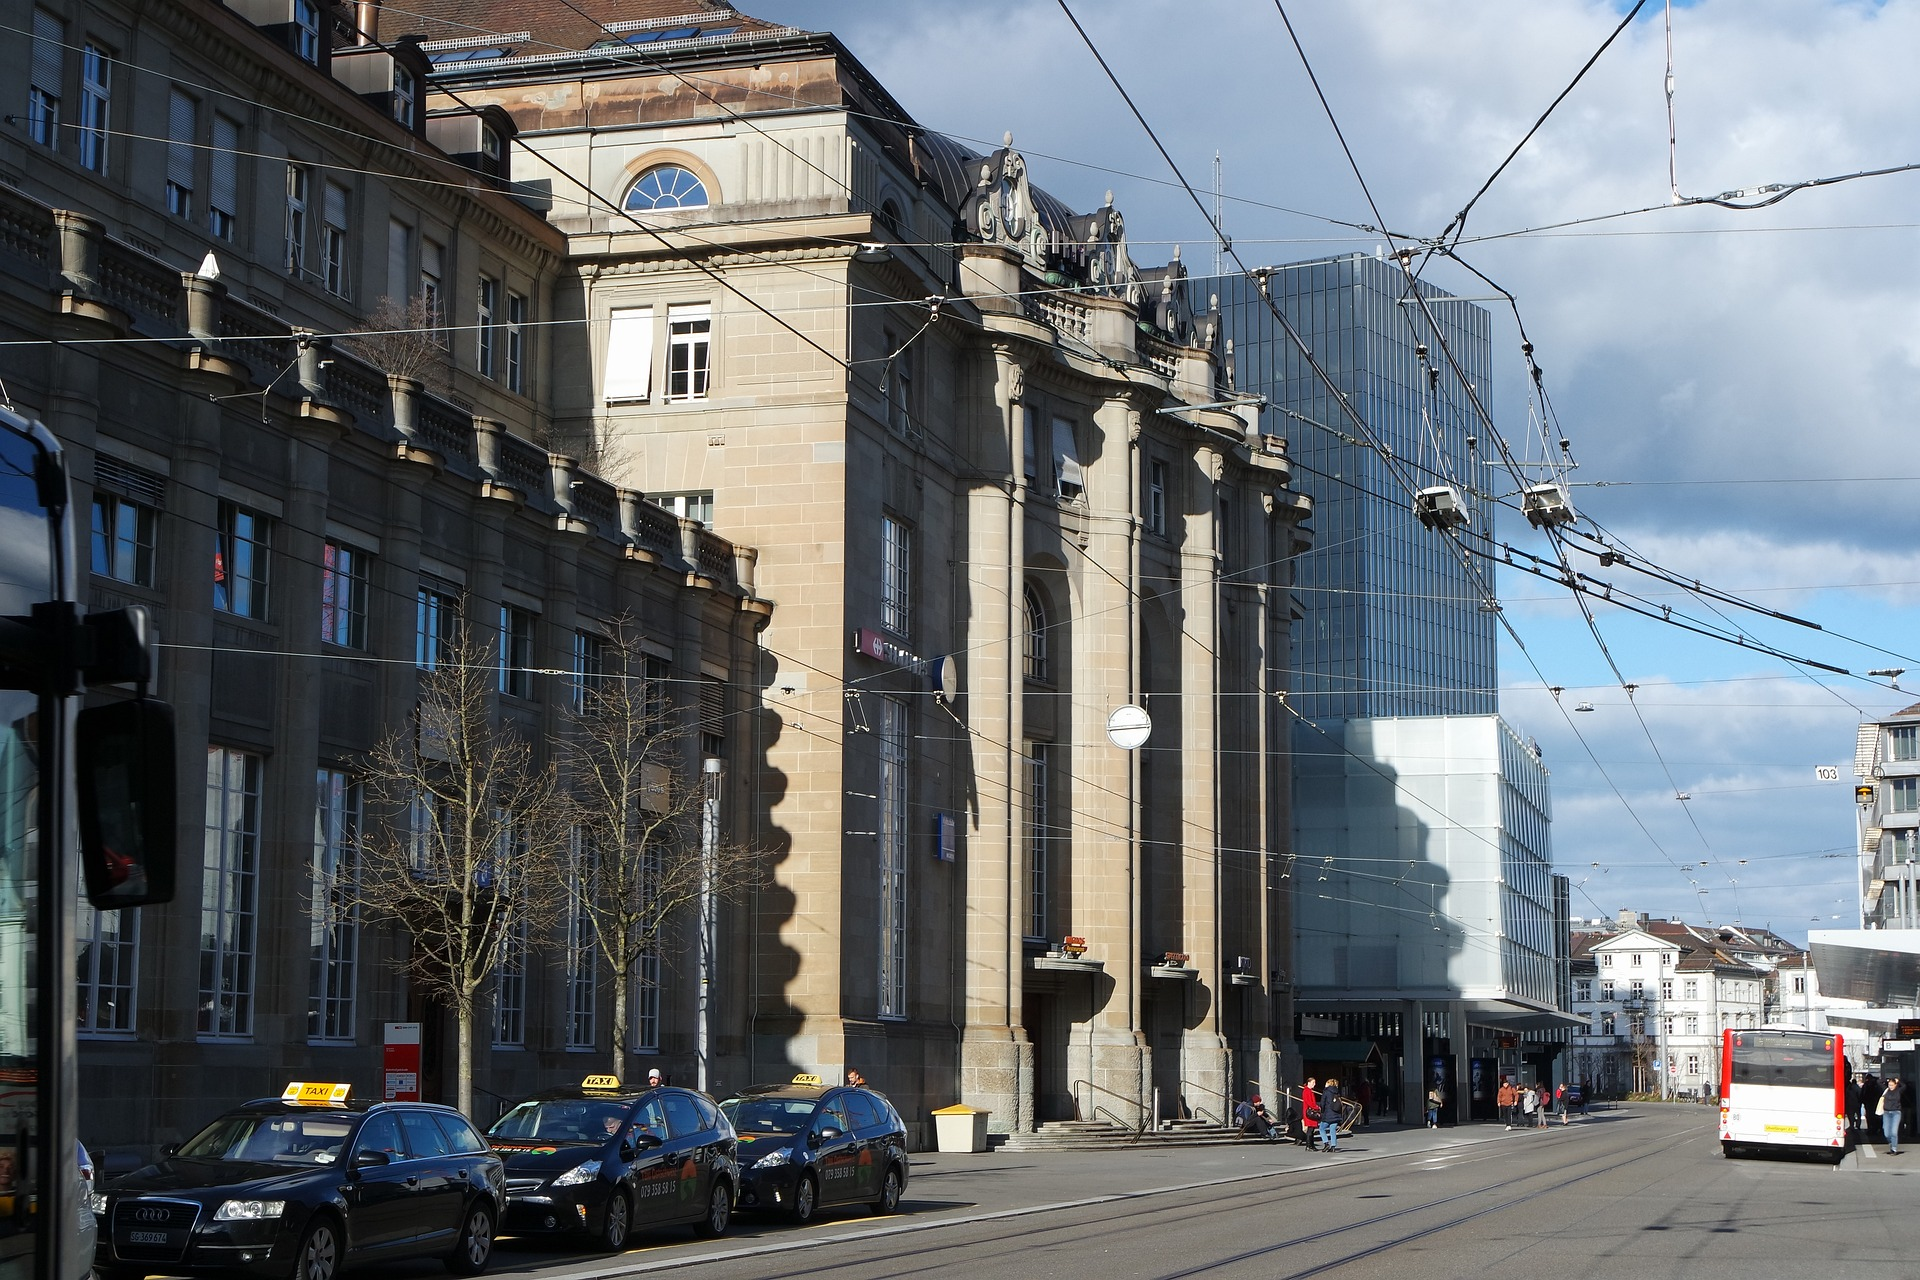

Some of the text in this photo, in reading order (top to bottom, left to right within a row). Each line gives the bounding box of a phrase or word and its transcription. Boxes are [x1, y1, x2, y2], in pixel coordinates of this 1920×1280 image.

[1818, 769, 1837, 779] 103
[587, 1077, 613, 1085] TAXI
[305, 1087, 329, 1095] TAXI
[849, 1166, 855, 1177] 15
[640, 1180, 676, 1198] 079 358 58 15
